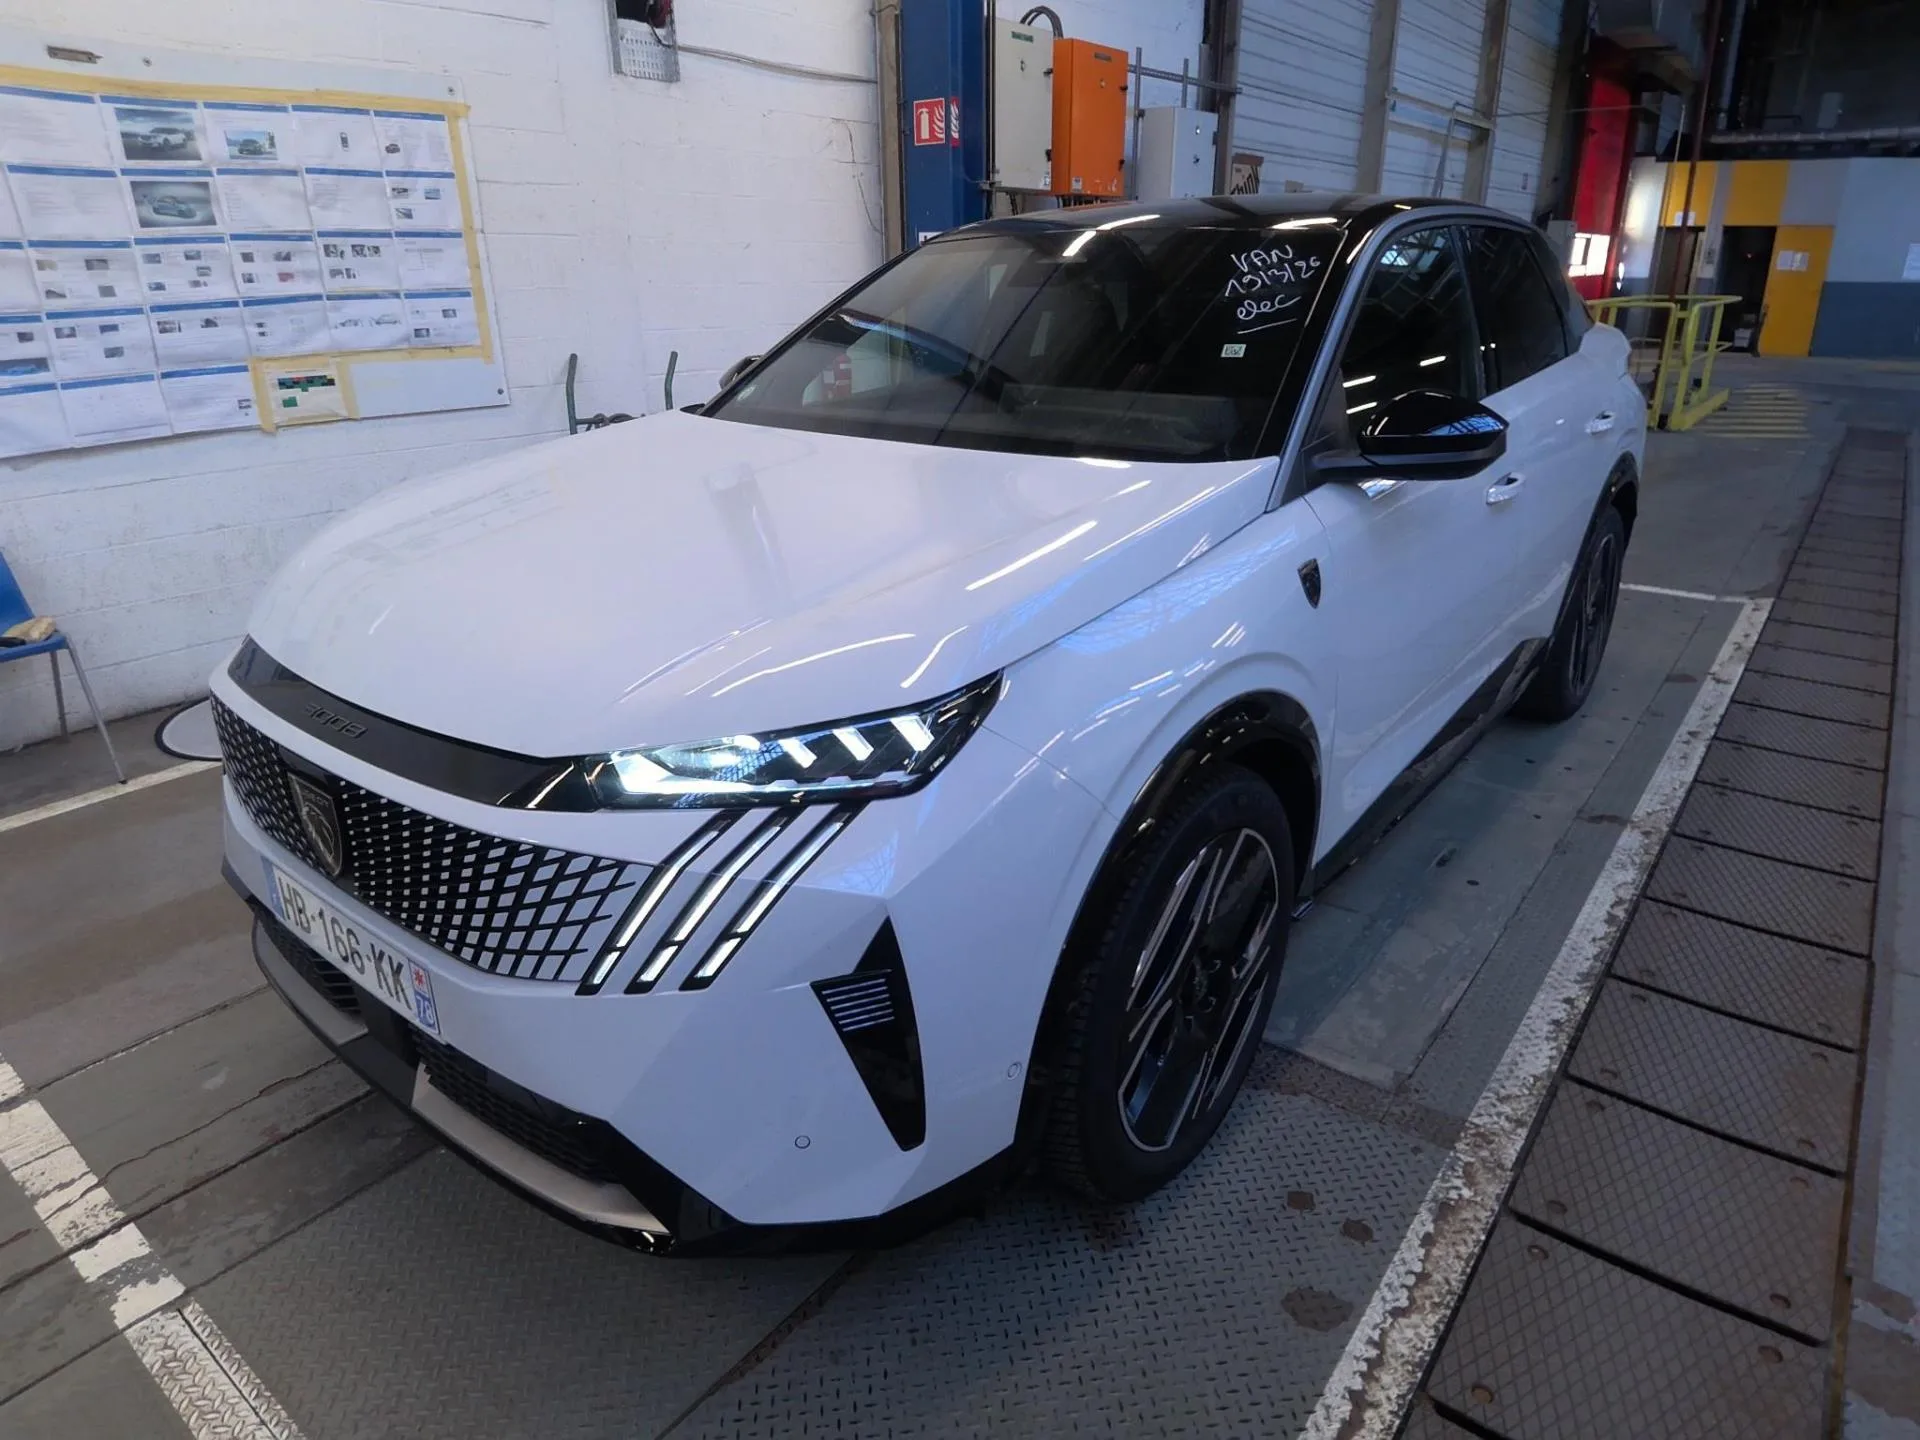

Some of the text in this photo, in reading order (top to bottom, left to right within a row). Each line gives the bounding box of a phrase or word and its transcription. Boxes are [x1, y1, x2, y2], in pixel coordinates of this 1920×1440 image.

[1230, 244, 1294, 273] VAN
[278, 876, 412, 1012] HB-166-KK
[416, 996, 435, 1026] 78
